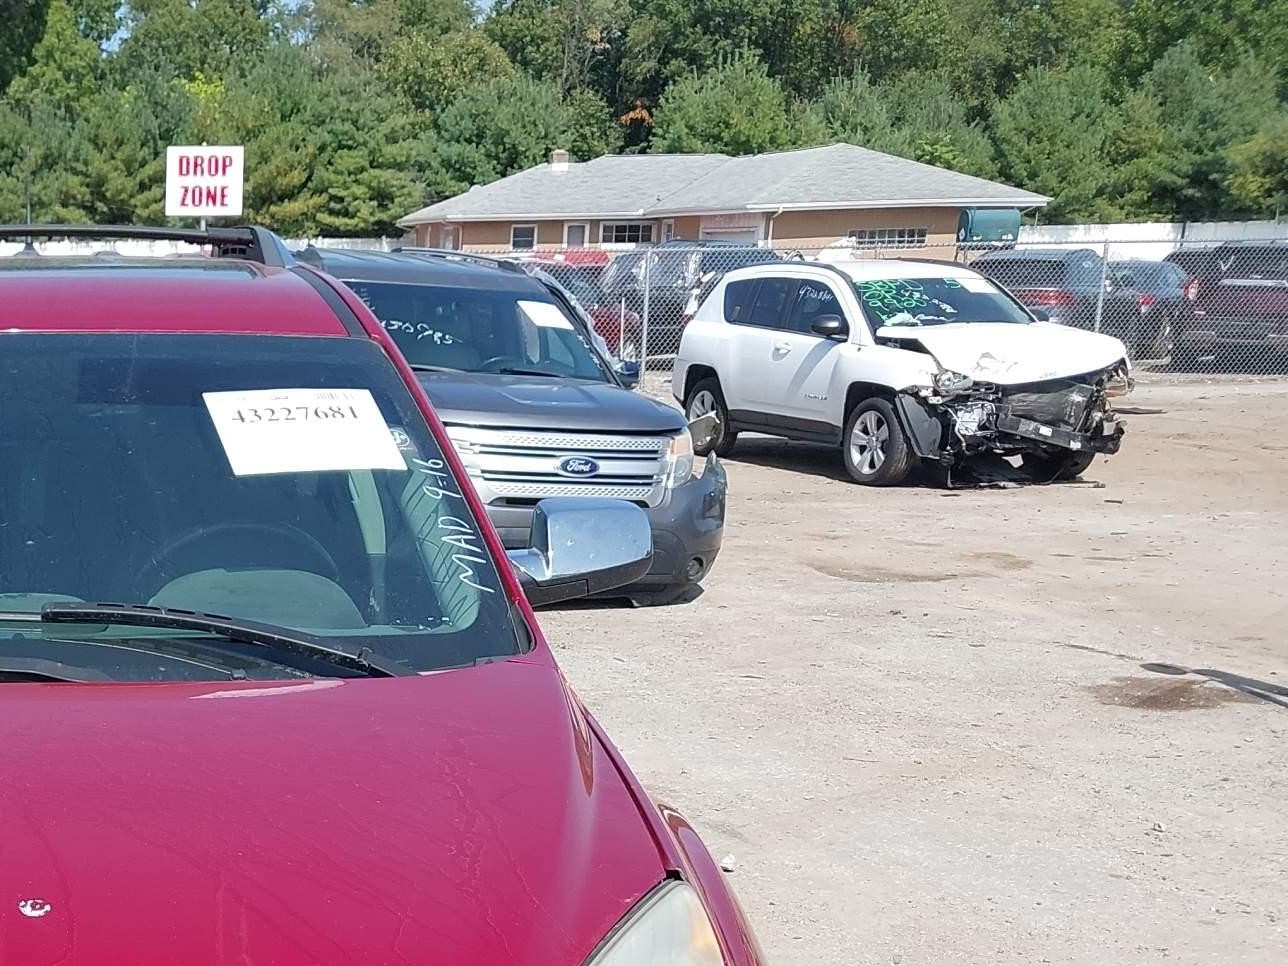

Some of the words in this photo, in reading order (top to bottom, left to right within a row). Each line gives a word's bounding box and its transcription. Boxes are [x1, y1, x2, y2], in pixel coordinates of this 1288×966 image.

[178, 155, 233, 177] DROP
[179, 185, 229, 207] ZONE
[231, 405, 360, 423] 43227681
[567, 459, 591, 471] Ford
[438, 516, 495, 592] MAD
